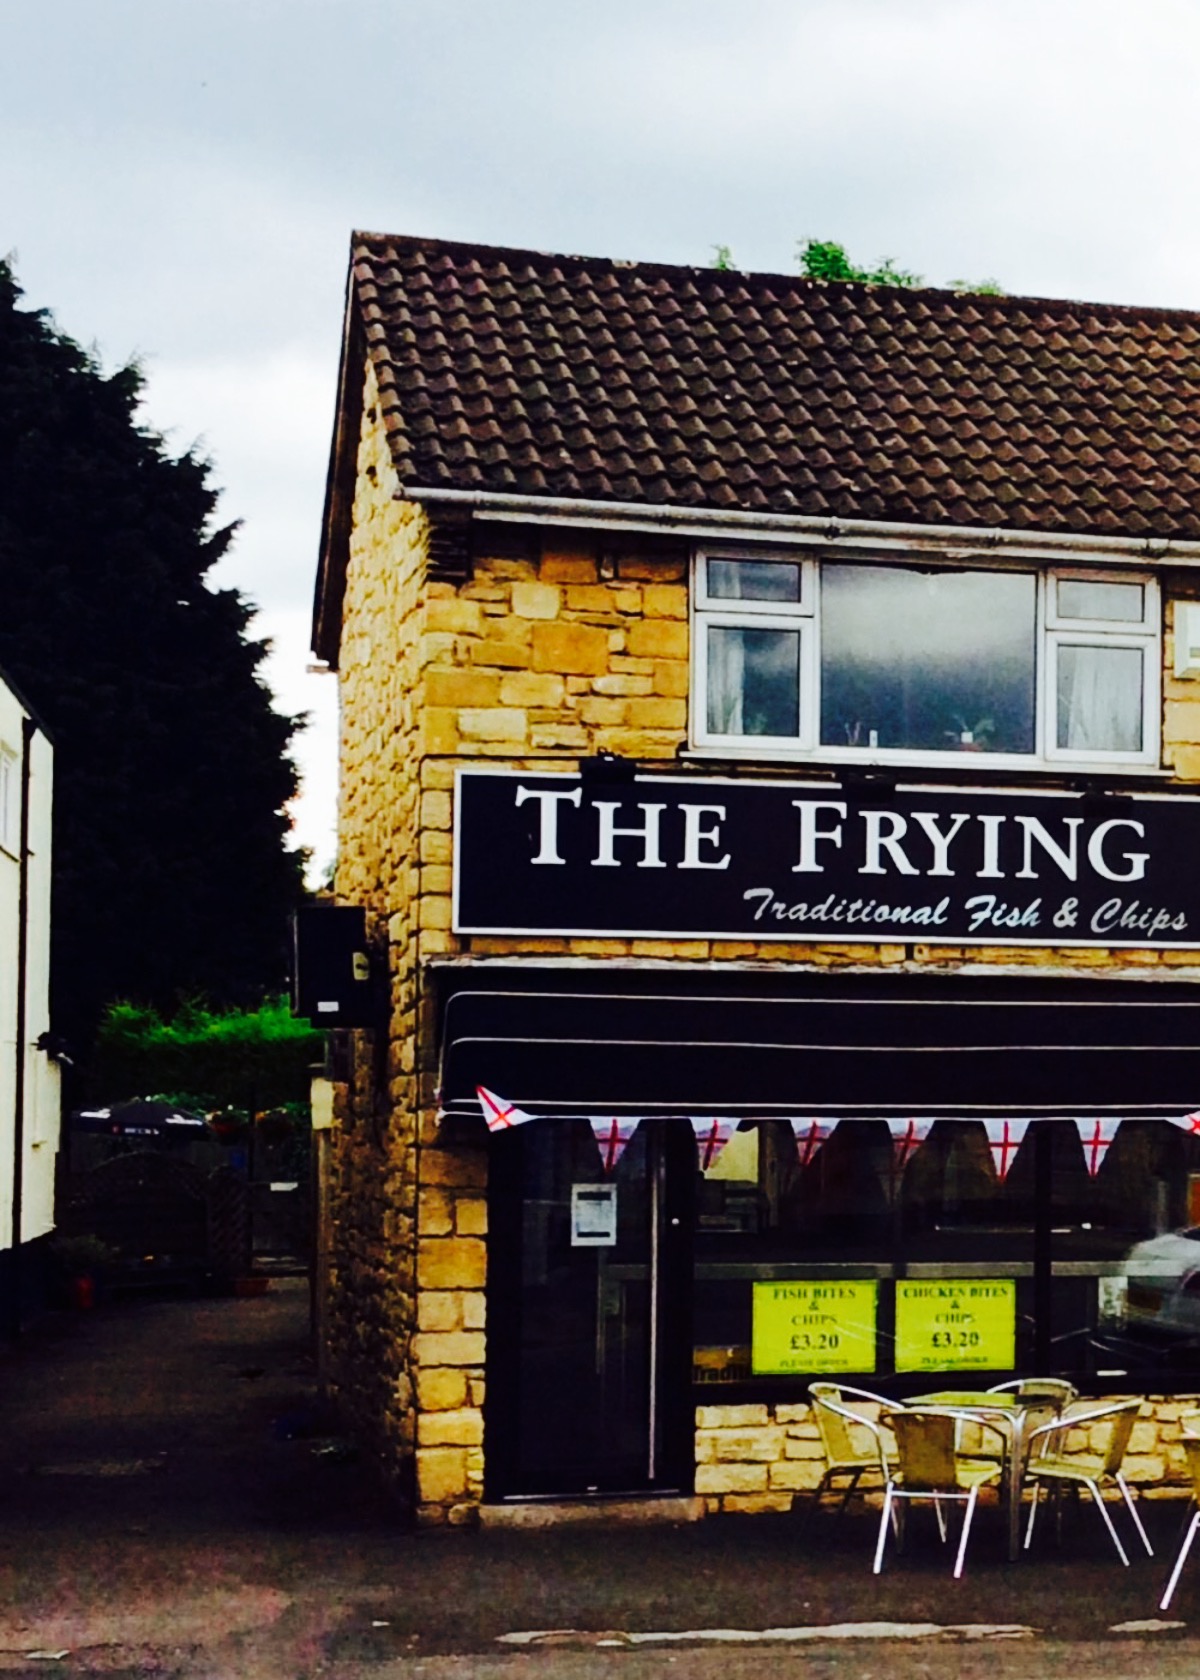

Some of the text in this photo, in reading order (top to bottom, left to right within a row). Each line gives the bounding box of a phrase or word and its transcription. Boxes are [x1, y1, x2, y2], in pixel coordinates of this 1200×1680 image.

[515, 785, 731, 870] THE
[791, 800, 1151, 882] FRYING
[743, 887, 1189, 937] Traditional Fish & Chips
[774, 1287, 857, 1300] FISH BITES
[903, 1286, 1009, 1298] CHICKEN BITES
[791, 1314, 838, 1326] CHIPS
[790, 1333, 840, 1350] £3.20
[931, 1331, 980, 1349] £3.20
